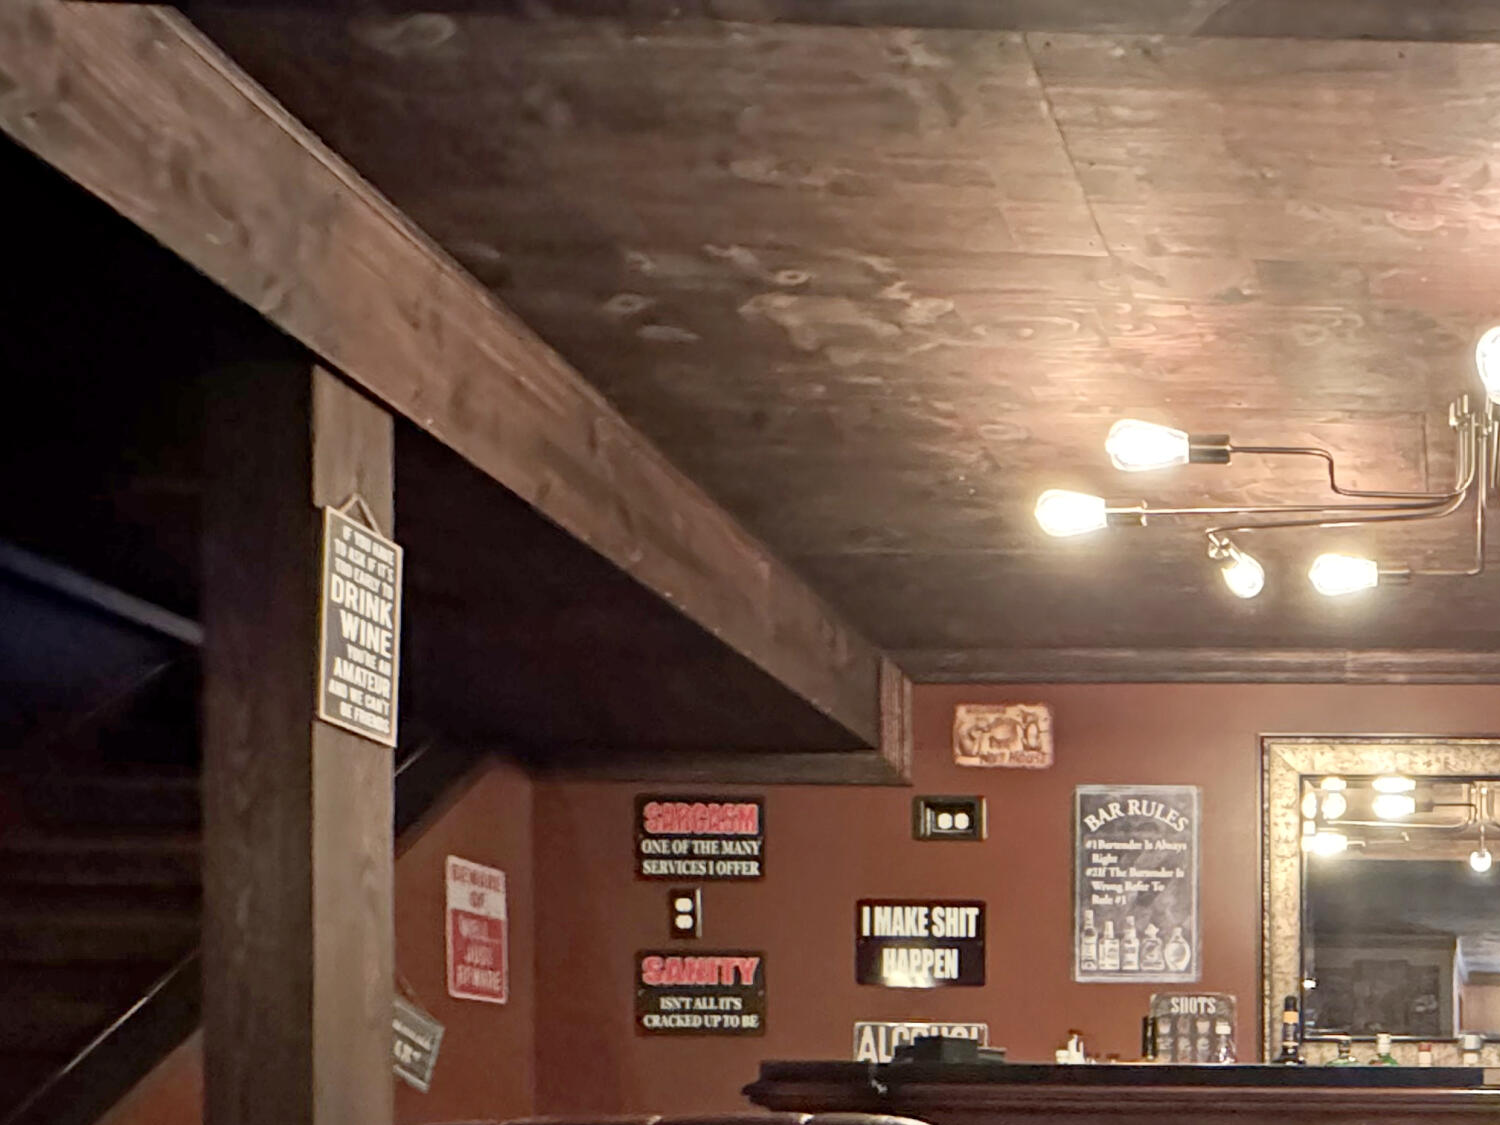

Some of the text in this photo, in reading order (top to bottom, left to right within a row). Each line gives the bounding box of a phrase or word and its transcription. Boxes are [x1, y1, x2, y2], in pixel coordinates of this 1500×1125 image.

[330, 573, 393, 630] DRINK
[340, 608, 393, 660] WINE
[333, 656, 391, 700] AMATEUR
[643, 801, 759, 836] SARCASM
[1083, 799, 1190, 833] BAR RULES
[641, 839, 762, 856] ONE OF THE MANY
[642, 860, 707, 875] SERVICES
[715, 861, 760, 876] OFFER
[862, 906, 980, 938] I MAKE SHIT
[642, 955, 761, 986] SANITY
[882, 948, 959, 980] HAPPEN
[693, 996, 718, 1010] ALL
[1171, 996, 1216, 1014] SHOTS
[643, 1014, 760, 1028] CRACKED UP TO BE
